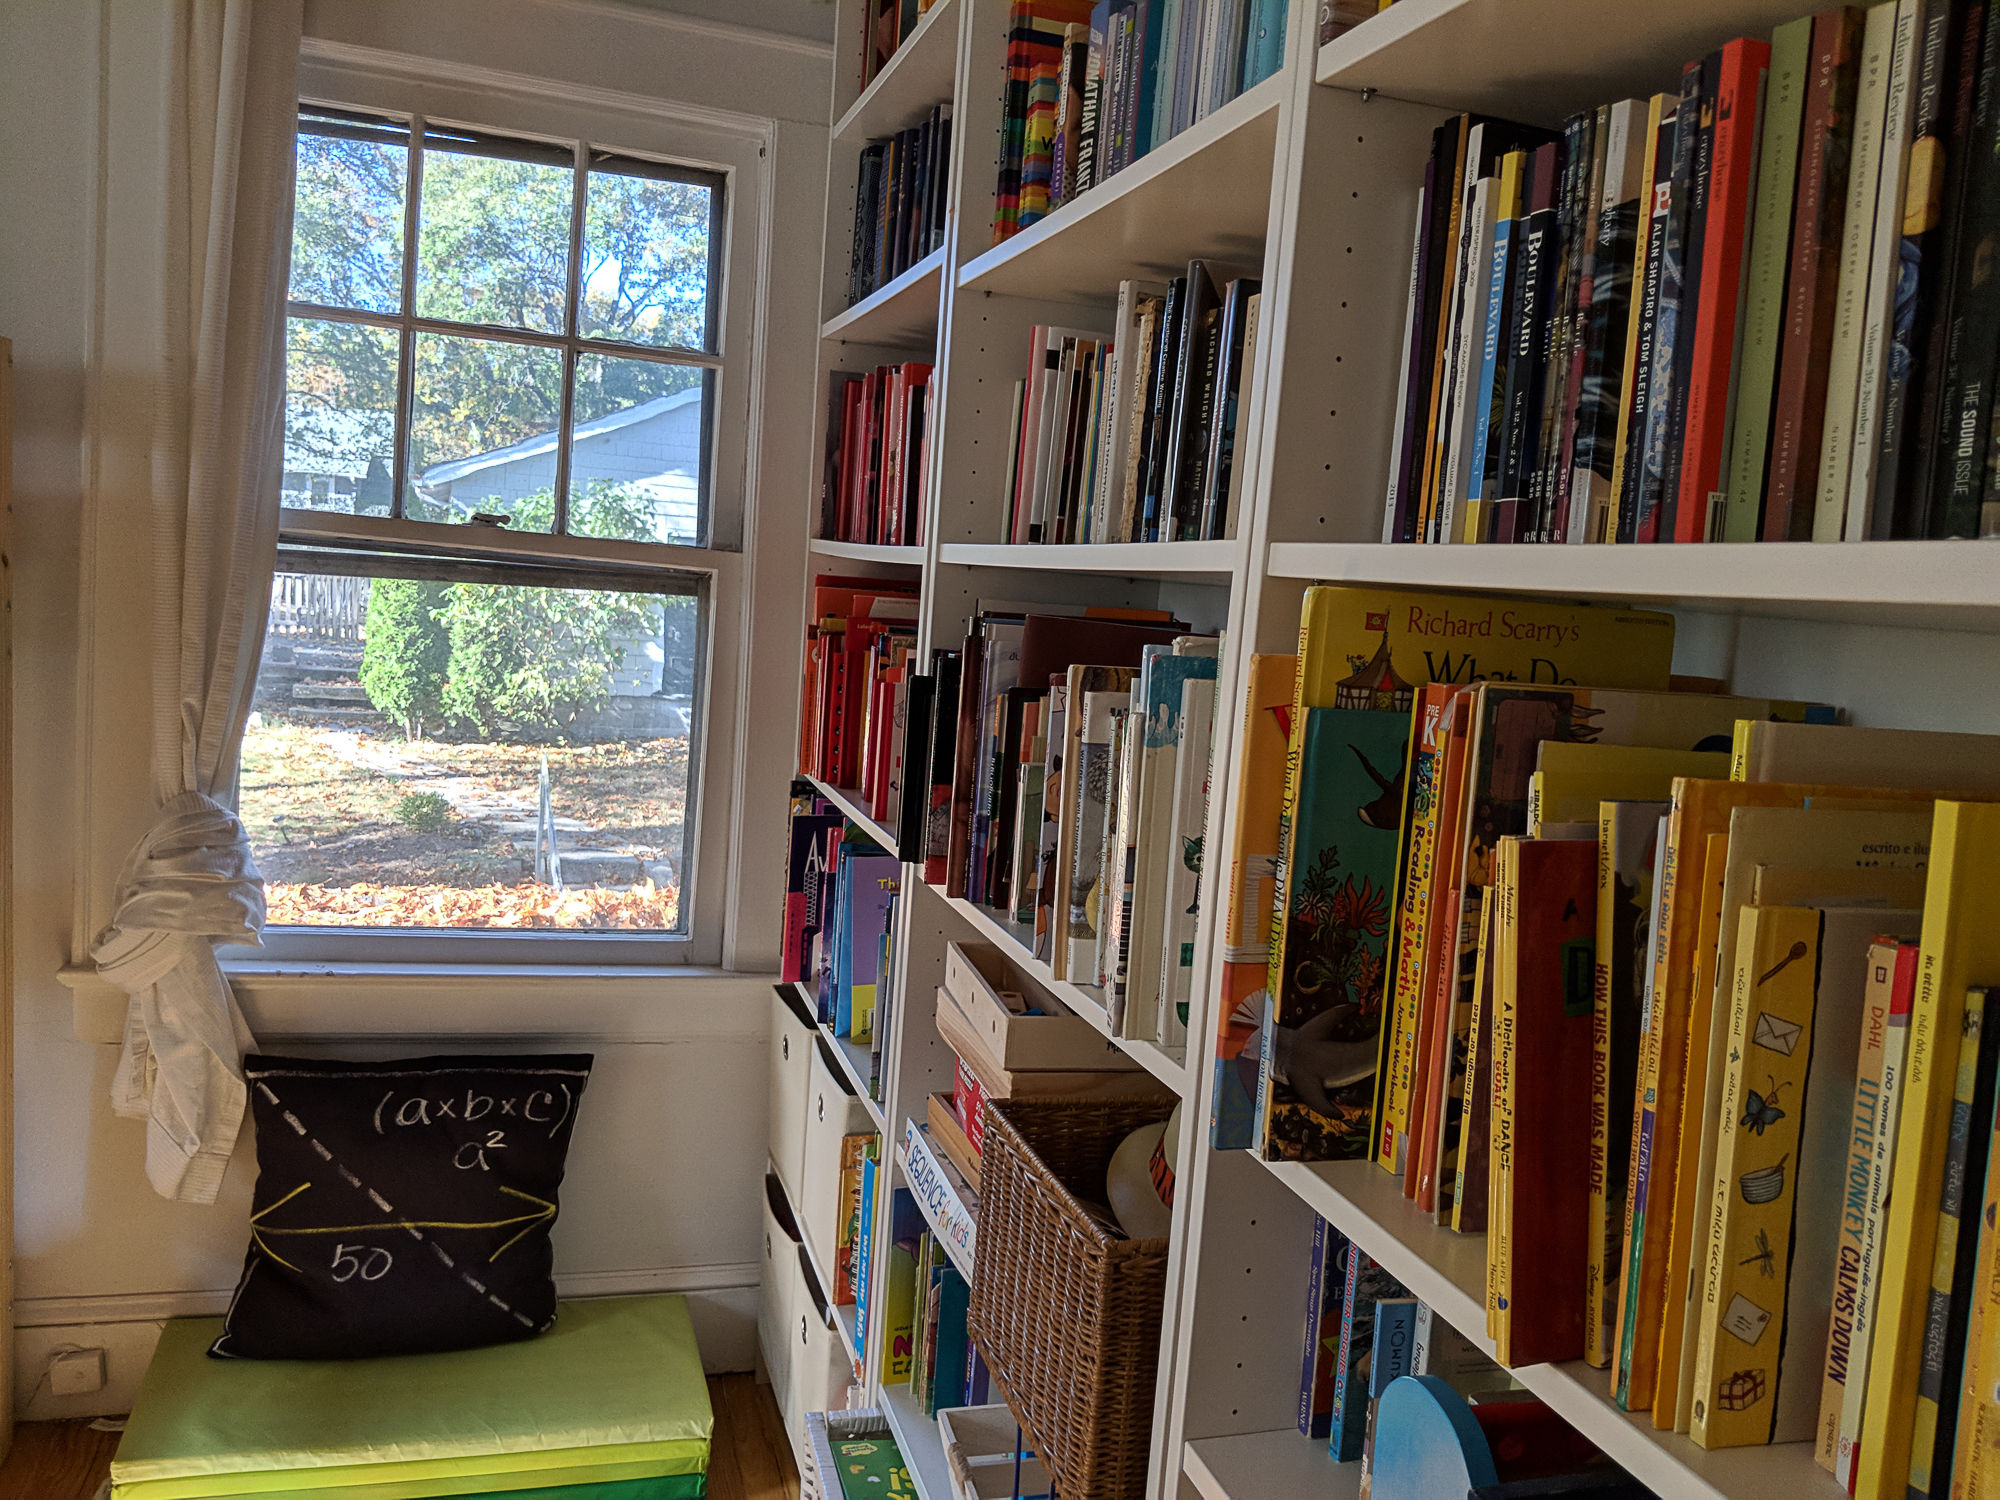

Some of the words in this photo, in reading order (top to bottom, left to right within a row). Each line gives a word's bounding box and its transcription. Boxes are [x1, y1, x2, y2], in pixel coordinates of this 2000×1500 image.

[1892, 13, 1913, 79] Indiana
[1921, 14, 1946, 80] Indiana
[1080, 47, 1101, 134] JONATHAN
[1780, 70, 1792, 104] BPR
[1818, 54, 1831, 88] BPR
[1867, 54, 1880, 88] BPR
[1887, 82, 1906, 141] Review
[1915, 82, 1937, 141] Review
[1054, 143, 1063, 192] MURAKAMI
[1694, 136, 1709, 209] crazyhorse
[1806, 119, 1823, 209] BIRMINGHAM
[1855, 120, 1873, 210] BIRMINGHAM
[1649, 222, 1663, 256] ALAN
[1799, 221, 1813, 271] POETRY
[1484, 237, 1508, 360] BOULEVARD
[1518, 229, 1543, 356] BOULEVARD
[1645, 262, 1659, 317] SHAPIRO
[1163, 316, 1173, 345] Practice
[1643, 321, 1652, 332] &
[1793, 287, 1807, 337] REVIEW
[1840, 289, 1855, 339] REVIEW
[1206, 328, 1218, 377] RICHARD
[1459, 334, 1470, 378] SYCAMORE
[1541, 321, 1554, 364] Rattle
[1550, 318, 1563, 360] Rattle
[1558, 315, 1572, 360] Rattle
[1572, 312, 1586, 357] Rattle
[1640, 336, 1652, 361] TOM
[1866, 323, 1880, 362] Volume
[1891, 329, 1905, 371] Volume
[1201, 384, 1212, 426] WRIGHT
[1635, 366, 1649, 413] SLEIGH
[1963, 382, 1981, 409] THE
[1858, 391, 1872, 434] Number
[1883, 397, 1898, 439] Number
[1957, 410, 1977, 457] SOUND
[1779, 421, 1792, 474] NUMBER
[1827, 426, 1841, 480] NUMBER
[1194, 460, 1203, 490] NATIVE
[1953, 460, 1972, 496] ISSUE
[1407, 605, 1492, 638] Richard
[1499, 611, 1580, 648] Scarry's
[1295, 626, 1308, 678] Richard
[1289, 679, 1302, 736] Scarry's
[1425, 703, 1440, 718] PRE
[1422, 715, 1439, 747] K
[1283, 749, 1298, 791] What
[1280, 797, 1292, 819] Do
[1404, 824, 1425, 914] Reading
[1599, 818, 1611, 889] barnett/rex
[1861, 843, 1900, 855] escrito
[1403, 916, 1416, 933] &
[1505, 883, 1515, 928] Murphy
[1267, 928, 1280, 969] Day?
[1397, 936, 1415, 997] Math
[1595, 964, 1609, 1003] HOW
[1393, 1002, 1406, 1046] Jumbo
[1471, 1003, 1480, 1024] Bed
[1503, 1001, 1513, 1012] A
[1593, 1007, 1608, 1044] THIS
[1867, 1005, 1885, 1050] DAHL
[1258, 1035, 1269, 1080] RANDOM
[1467, 1036, 1476, 1054] for
[1500, 1017, 1513, 1091] Dictionary
[1639, 1017, 1650, 1057] Medeiros
[1388, 1048, 1401, 1113] Workbook
[1464, 1057, 1475, 1095] Enough
[1592, 1051, 1607, 1097] BOOK
[1885, 1065, 1895, 1091] 100
[1255, 1081, 1266, 1114] HOUSE
[1462, 1098, 1471, 1115] Big
[1849, 1077, 1880, 1153] LITTLE
[1878, 1094, 1890, 1137] nomes
[1590, 1101, 1605, 1139] WAS
[1631, 1111, 1641, 1138] JOÃO
[1499, 1119, 1511, 1172] DANCE
[1630, 1139, 1638, 1161] MEU
[908, 1144, 947, 1217] SEQUENCE
[938, 1199, 953, 1231] for
[1588, 1144, 1603, 1195] MADE
[1869, 1163, 1883, 1214] animais
[1624, 1180, 1636, 1228] CORAÇÃO
[1844, 1153, 1872, 1244] MONKEY
[1711, 1206, 1723, 1240] שולח
[330, 1243, 393, 1283] 50
[1310, 1265, 1318, 1285] Spot
[1488, 1263, 1498, 1290] Henry
[1587, 1263, 1600, 1297] Disney
[1705, 1249, 1719, 1303] מכתבים
[1834, 1245, 1861, 1317] CALMS
[1855, 1217, 1879, 1333] português-inglês
[1308, 1287, 1317, 1312] Stays
[1304, 1313, 1315, 1358] Overnight
[1336, 1321, 1350, 1376] DOGGIES
[1827, 1316, 1856, 1387] DOWN
[1300, 1390, 1308, 1427] WARNE
[1825, 1413, 1836, 1458] capstone
